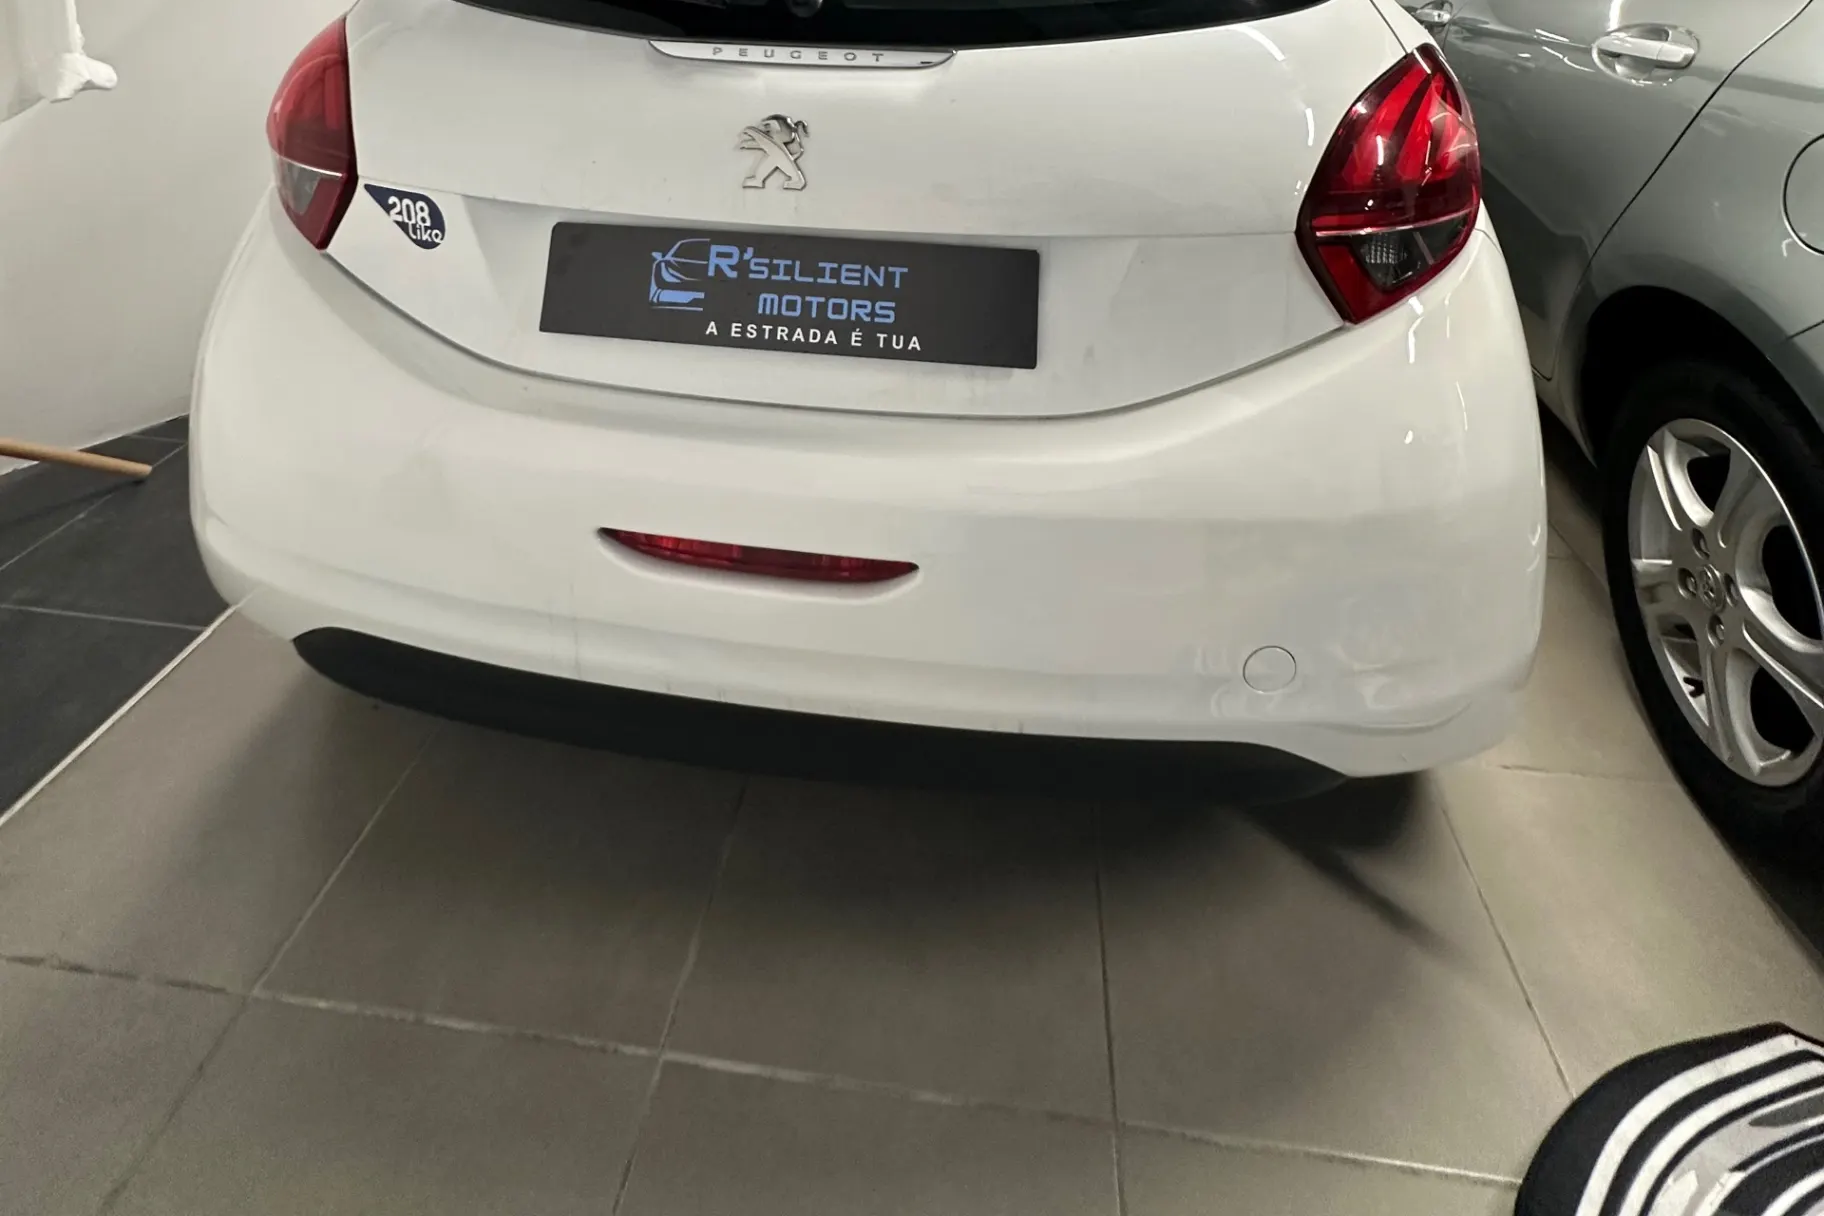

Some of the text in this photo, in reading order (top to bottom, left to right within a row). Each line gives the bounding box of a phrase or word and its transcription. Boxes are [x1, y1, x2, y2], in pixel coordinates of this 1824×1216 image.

[712, 46, 884, 63] PEUGEOT
[388, 195, 431, 226] 208
[707, 244, 909, 289] R'SILIENT
[757, 292, 896, 324] MOTORS
[705, 321, 922, 351] A ESTRADA É TUA
